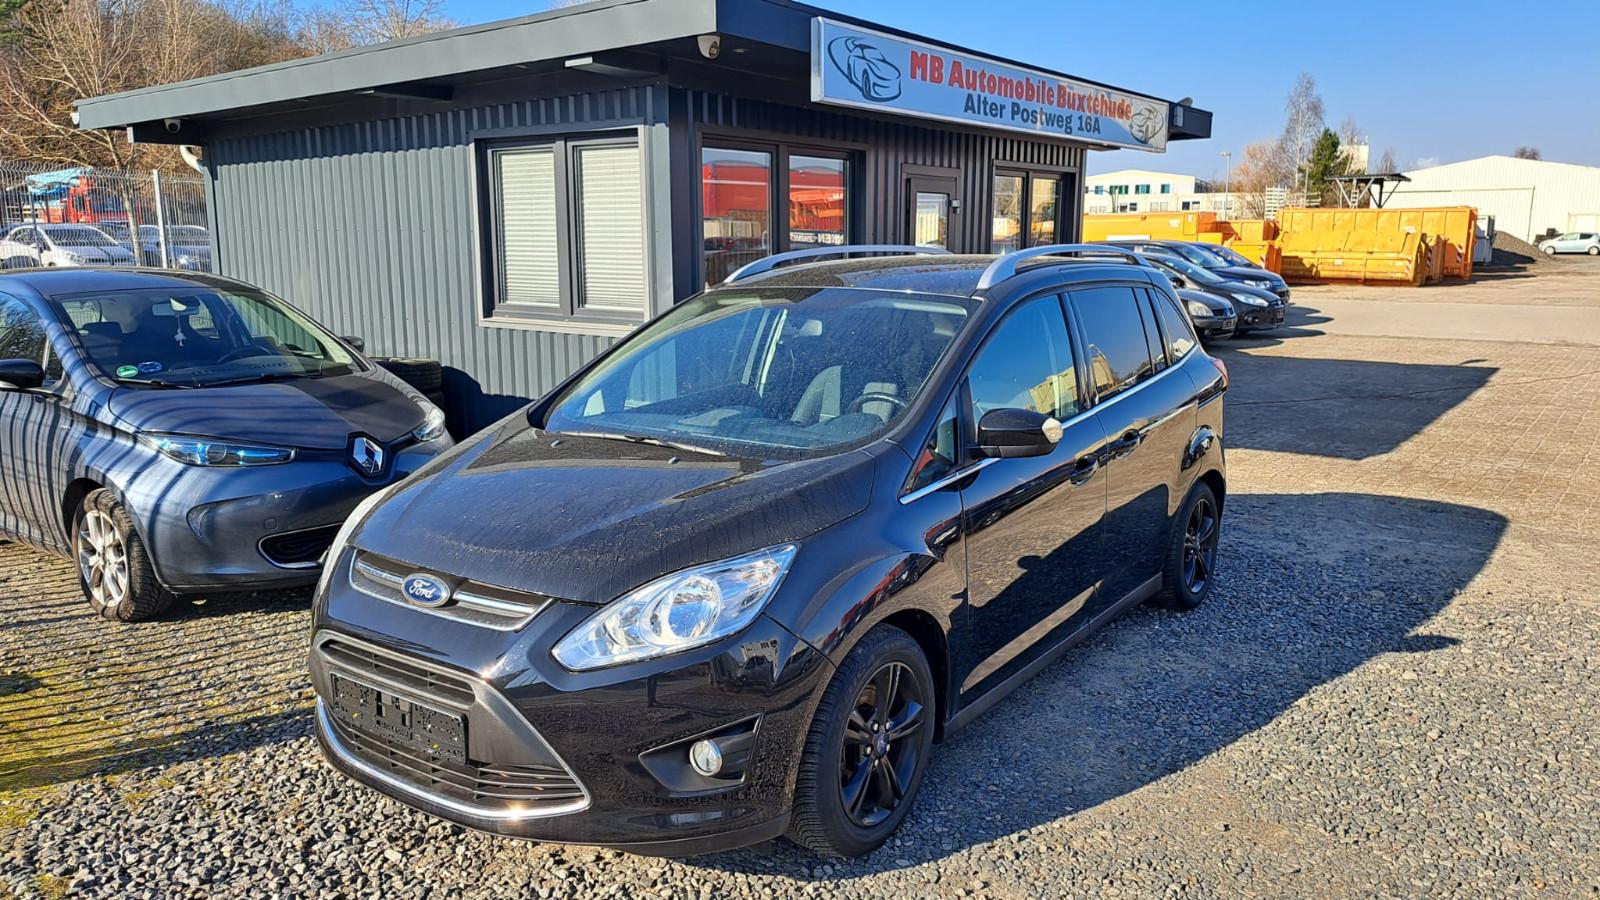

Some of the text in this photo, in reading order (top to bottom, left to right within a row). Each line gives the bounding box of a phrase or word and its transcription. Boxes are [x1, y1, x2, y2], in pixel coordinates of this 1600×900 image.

[910, 50, 1132, 121] MB Automobile Buxtehude
[963, 93, 1101, 134] Alter Postweg 16A
[409, 579, 437, 599] Ford
